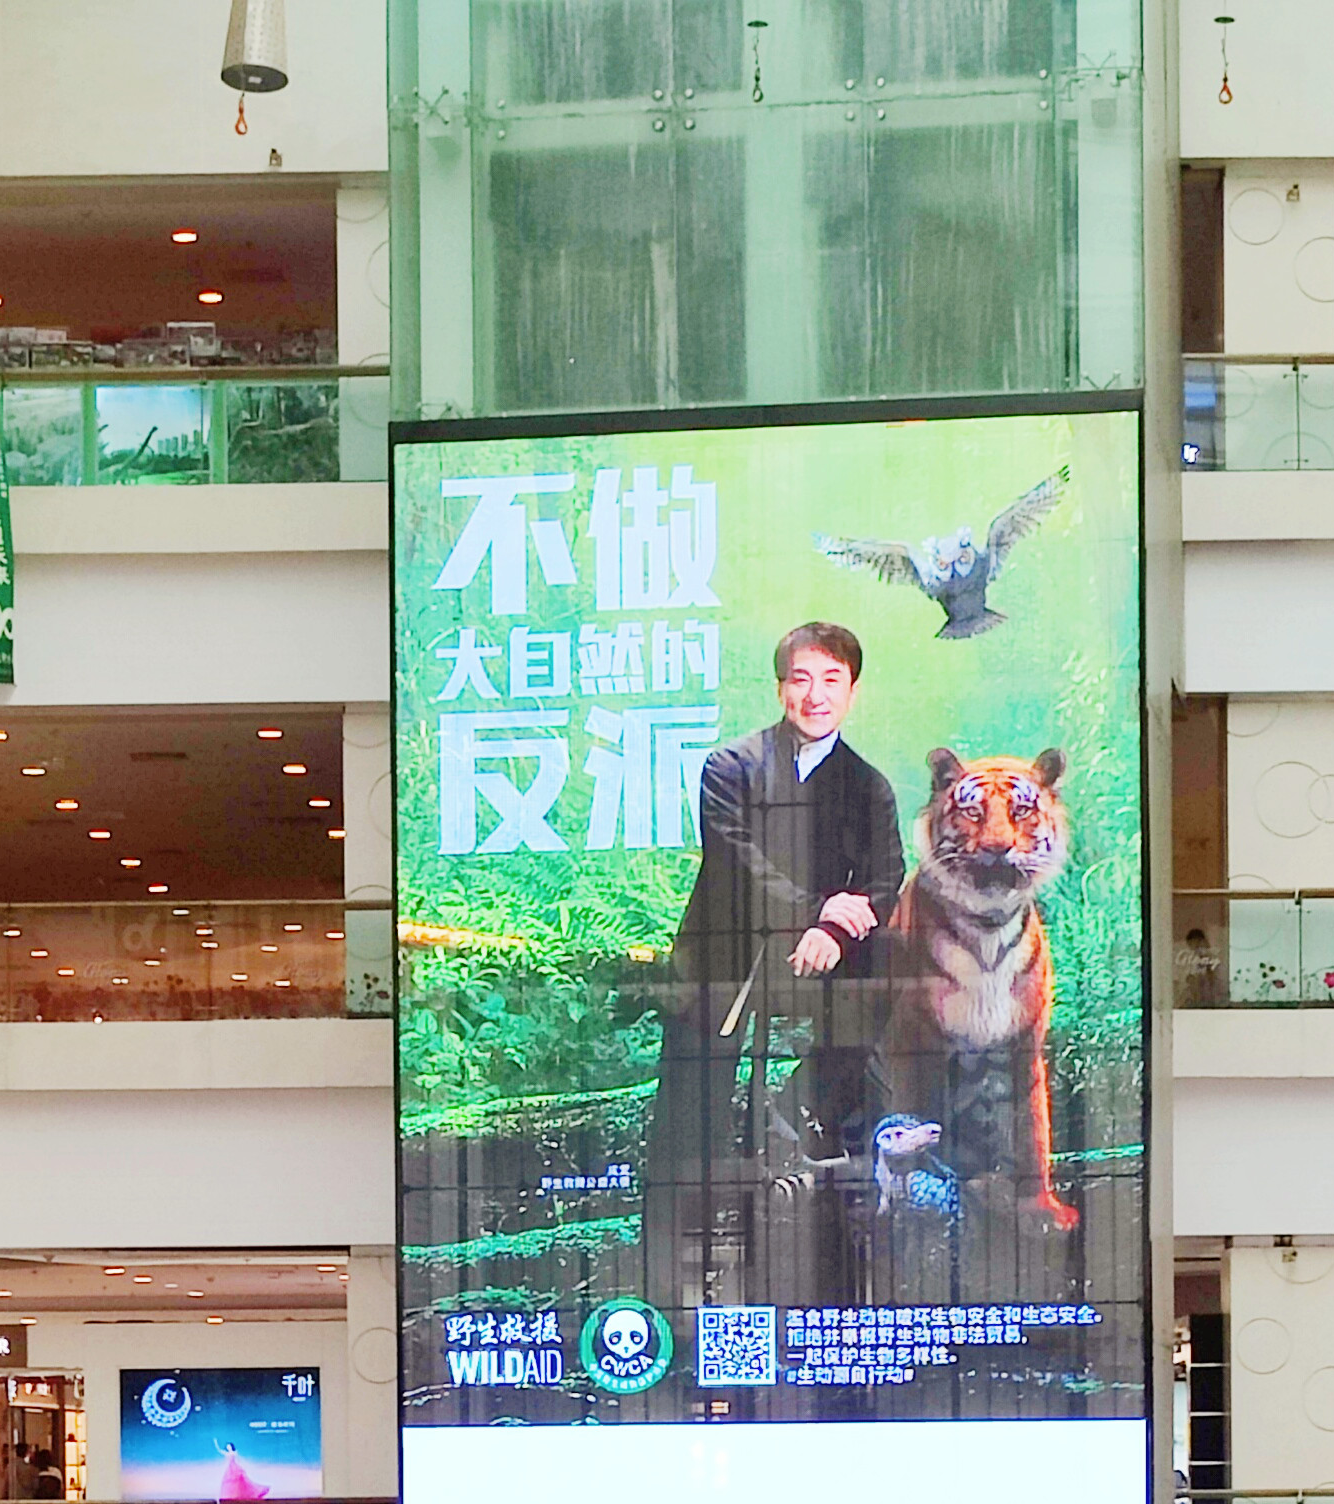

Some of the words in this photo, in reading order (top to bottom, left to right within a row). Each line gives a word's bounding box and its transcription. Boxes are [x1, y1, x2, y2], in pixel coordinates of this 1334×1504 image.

[432, 464, 722, 615] 不做
[435, 618, 722, 701] 大自然的
[437, 704, 722, 855] 反派
[447, 1350, 563, 1386] WILDAID
